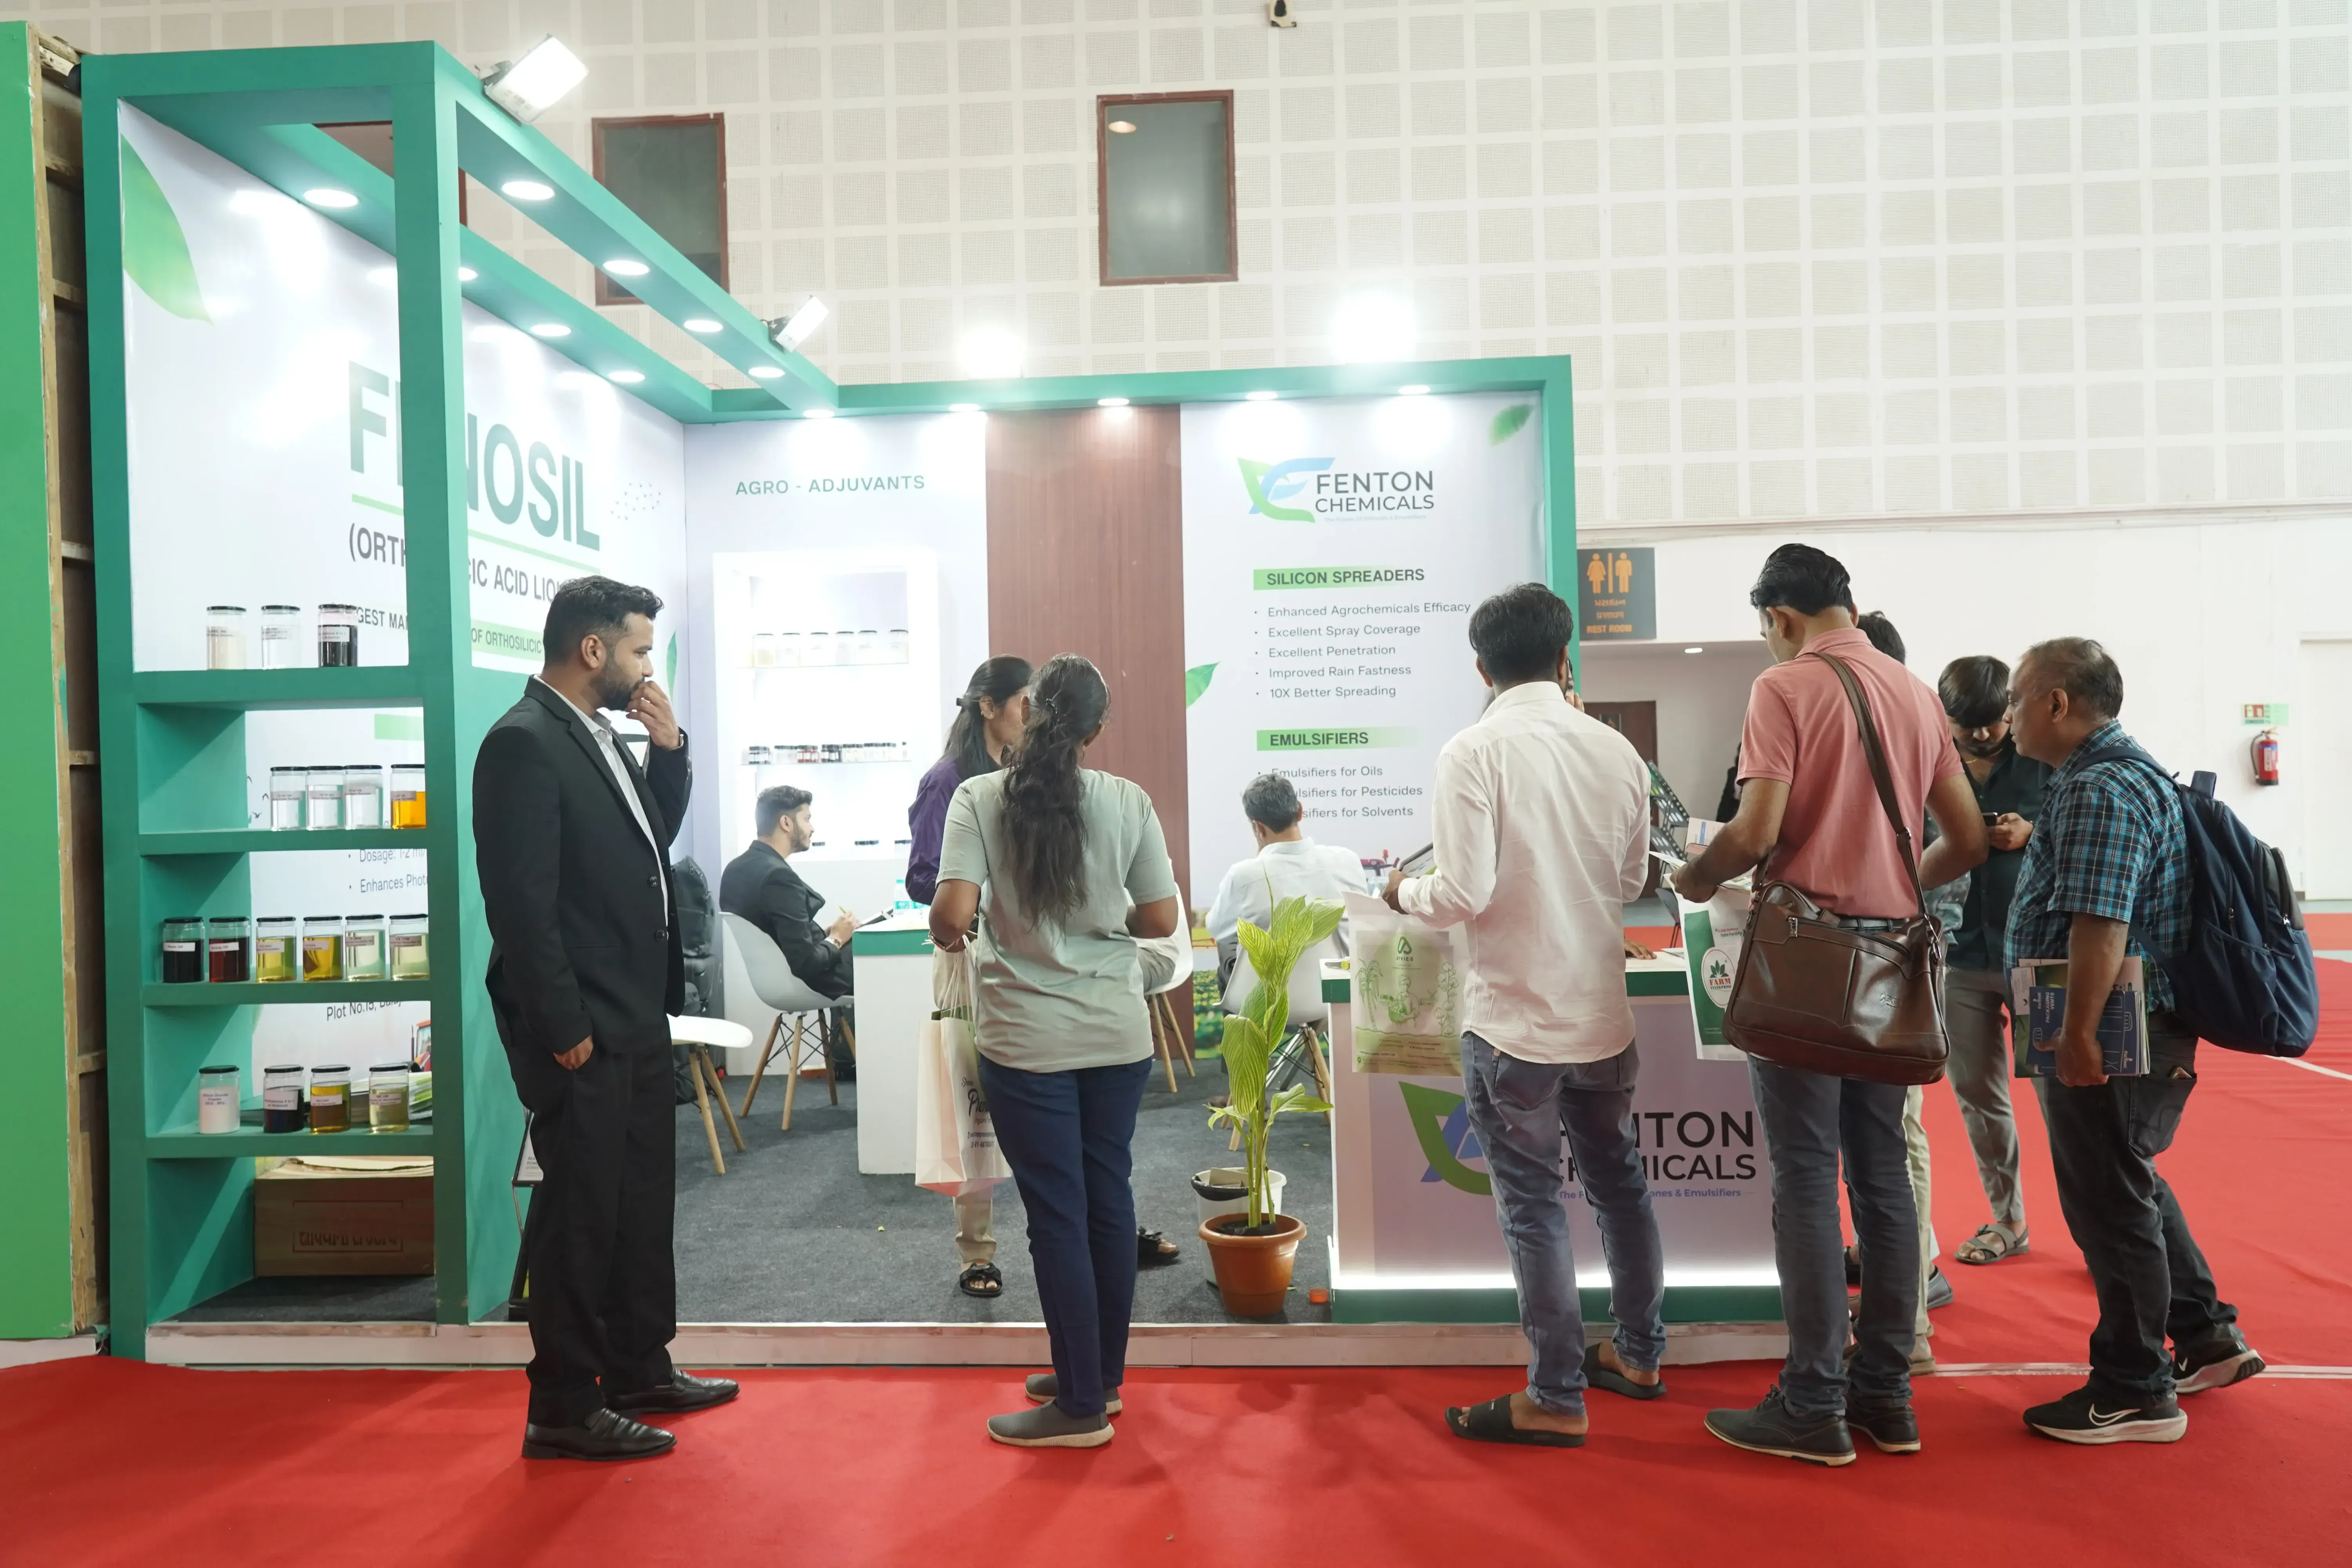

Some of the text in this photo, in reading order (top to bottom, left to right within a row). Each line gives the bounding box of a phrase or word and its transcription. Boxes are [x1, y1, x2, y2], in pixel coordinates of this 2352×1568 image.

[736, 481, 789, 495] AGRO
[809, 475, 925, 492] ADJUVANTS
[1317, 470, 1433, 494] FENTON
[1315, 495, 1434, 512] CHEMICALS
[494, 564, 528, 596] ACID
[1267, 569, 1425, 585] SILICON SPREADERS
[1269, 602, 1471, 617] Enhanced Agrochemicals Efficacy
[1269, 625, 1420, 637] Excellent Spray Coverage
[1587, 624, 1632, 633] REST ROOM
[472, 628, 542, 654] OF ORTHOSILICIC
[1269, 645, 1396, 658] Excellent Penetration
[1270, 665, 1411, 679] Improved Rain Fastness
[1270, 686, 1396, 699] 10X Better Spreading
[1270, 732, 1368, 746] EMULSIFIERS
[1341, 767, 1357, 776] for
[1361, 766, 1383, 776] Oils
[1341, 788, 1357, 797] for
[1362, 786, 1423, 796] Pesticides
[1342, 808, 1357, 817] for
[1362, 807, 1413, 817] Solvents
[360, 849, 396, 864] Dosage:
[361, 878, 403, 893] Enhances
[327, 1005, 346, 1021] Plot
[1684, 1189, 1741, 1197] Emulsifiers
